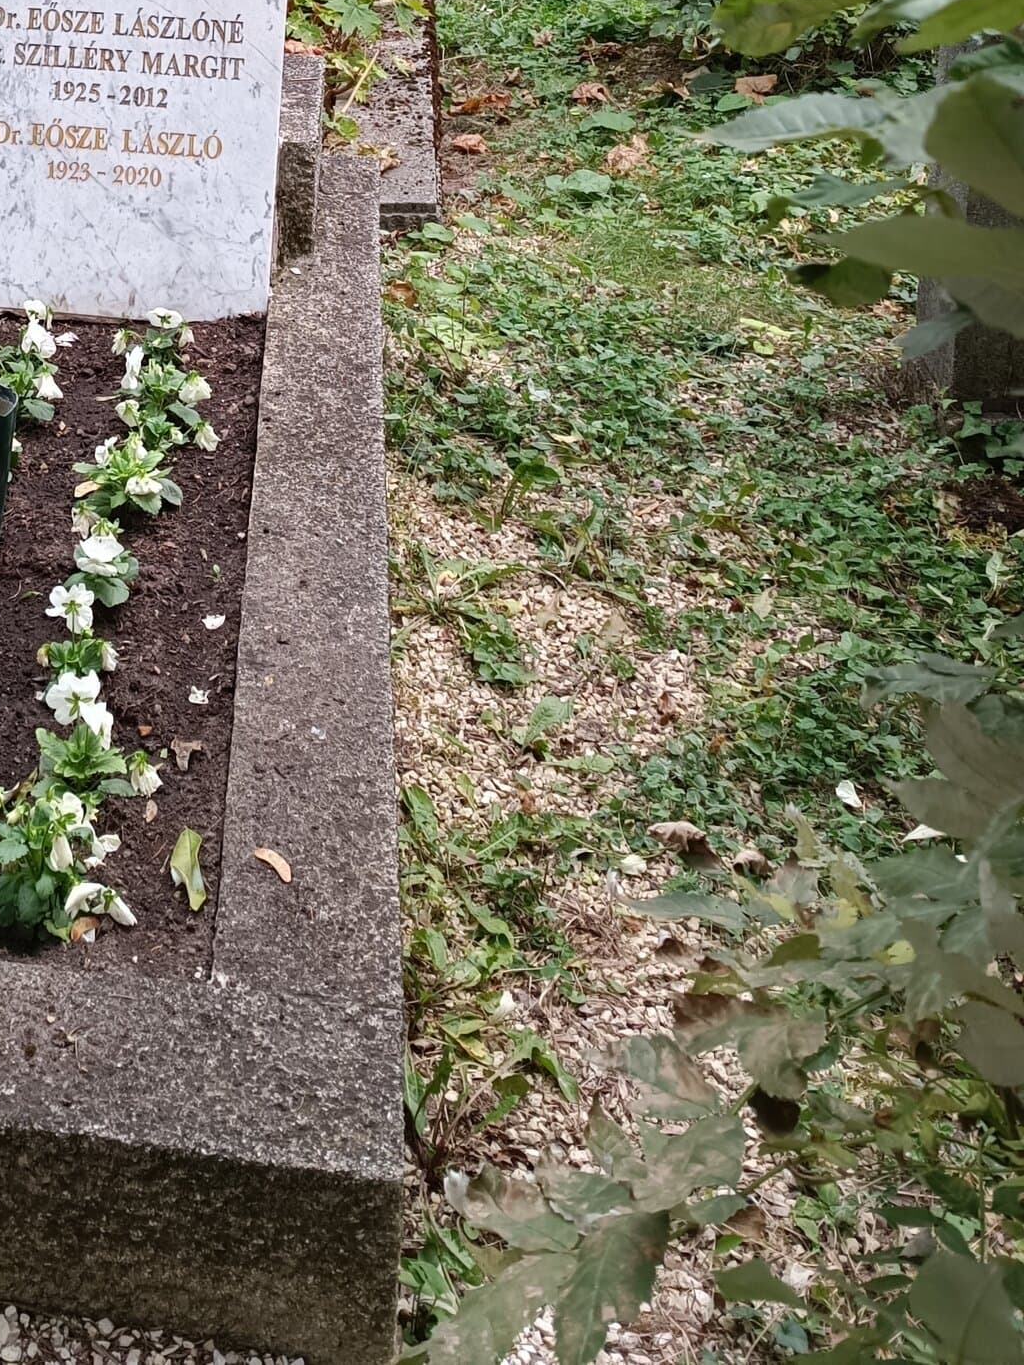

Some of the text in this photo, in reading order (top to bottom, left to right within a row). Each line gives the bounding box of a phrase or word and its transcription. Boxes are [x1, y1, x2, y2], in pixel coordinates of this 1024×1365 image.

[27, 2, 105, 34] EŐSZE
[112, 8, 245, 44] LÁSZLÓNÉ
[13, 41, 132, 72] SZILLÉRY
[140, 50, 246, 80] MARGIT
[51, 80, 102, 104] 1925
[119, 86, 169, 109] 2012
[30, 118, 108, 151] EŐSZE
[121, 124, 224, 160] LÁSZLÓ
[46, 160, 91, 182] 1923
[112, 164, 163, 187] 2020
